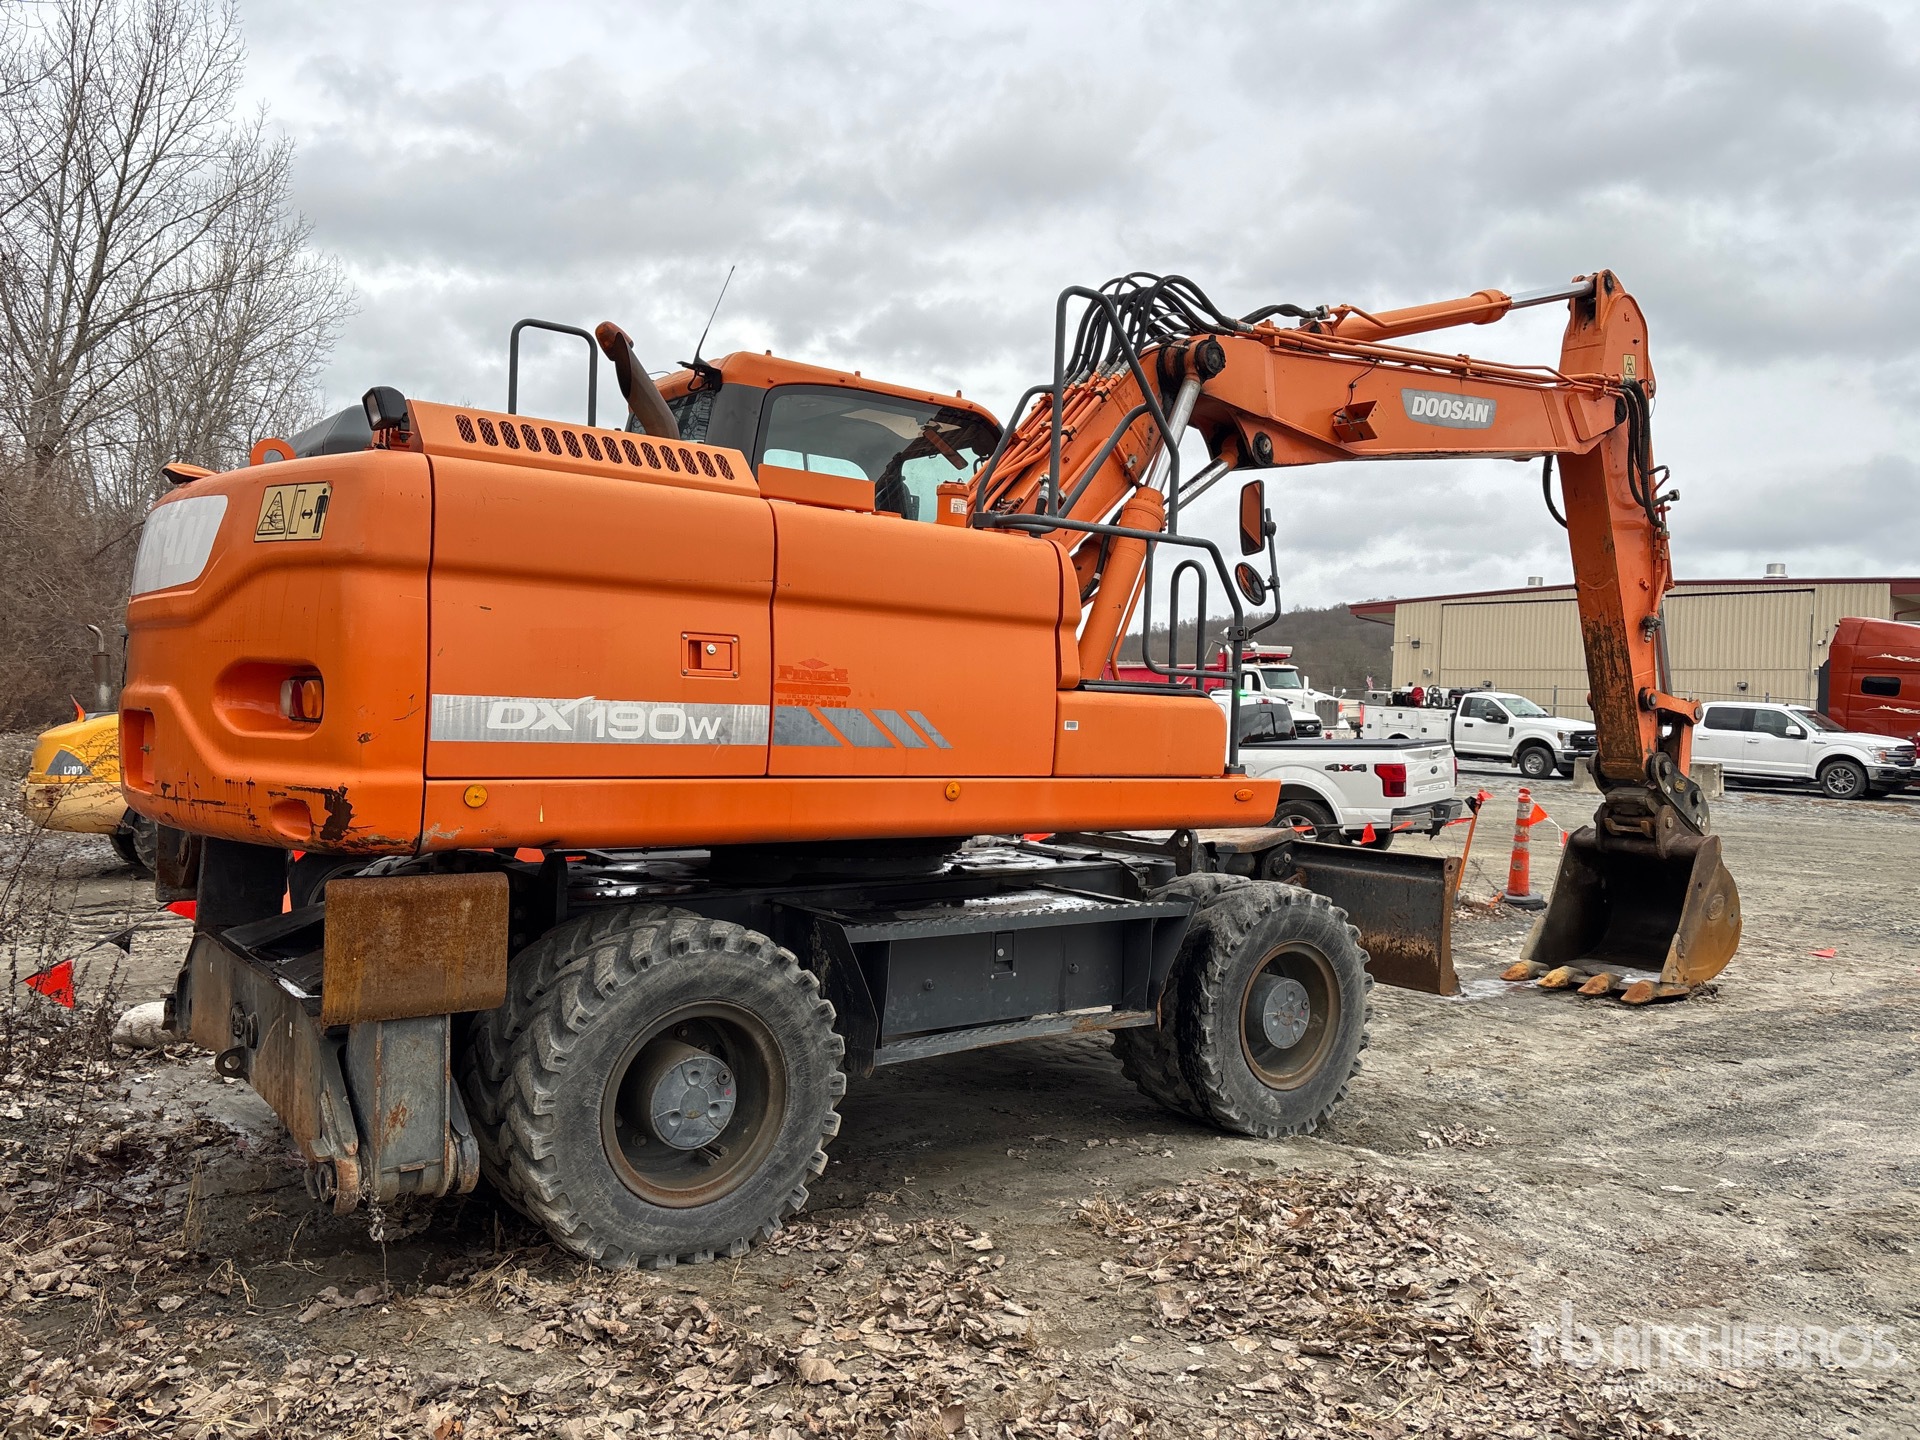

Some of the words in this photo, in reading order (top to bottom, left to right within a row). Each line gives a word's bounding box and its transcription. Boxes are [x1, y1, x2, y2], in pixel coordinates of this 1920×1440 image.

[1411, 396, 1489, 422] DOOSAN
[487, 696, 597, 732] DX
[1417, 782, 1446, 794] F-150
